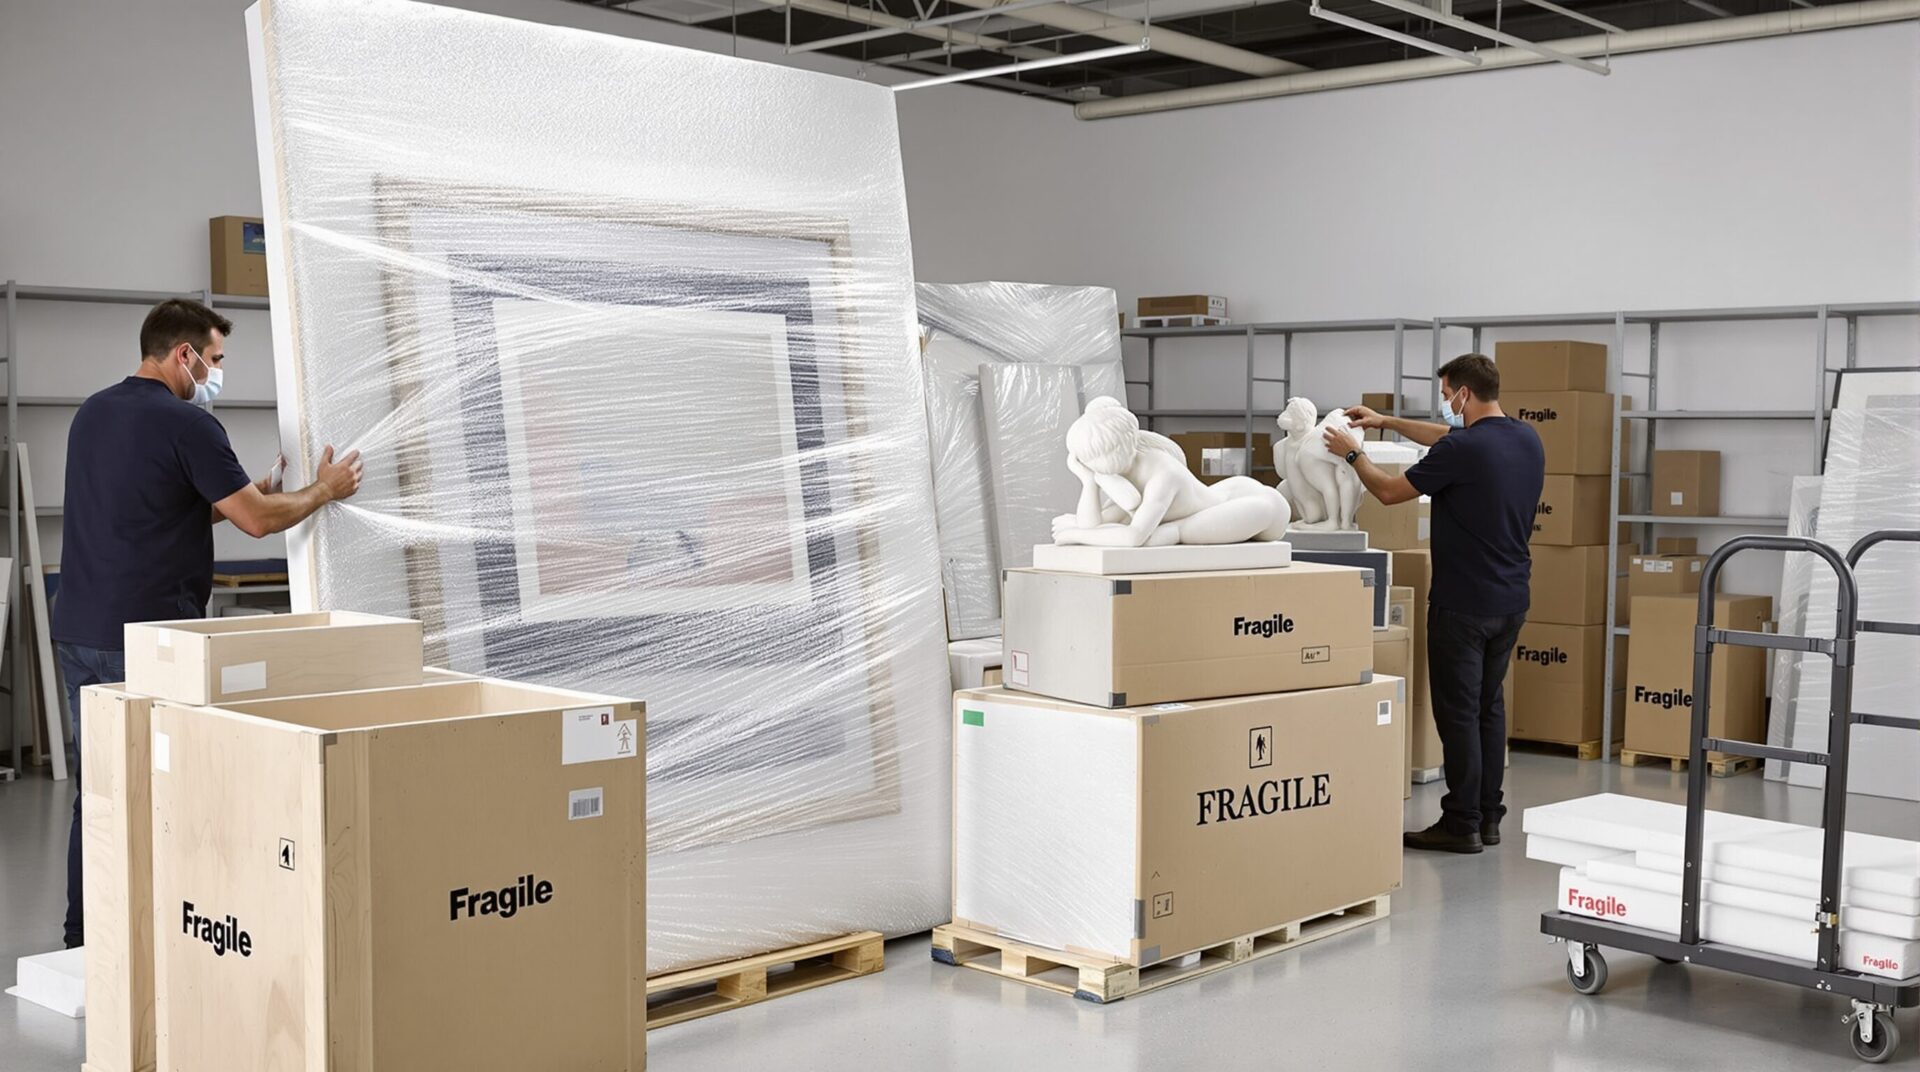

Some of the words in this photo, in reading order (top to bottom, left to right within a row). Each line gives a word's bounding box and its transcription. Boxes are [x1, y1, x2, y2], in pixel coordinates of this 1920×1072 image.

[1518, 408, 1557, 423] Fragile
[1234, 613, 1294, 639] Fragile
[1516, 645, 1567, 666] Fragile
[1634, 686, 1692, 709] Fragile
[1196, 773, 1331, 826] FRAGILE
[449, 873, 553, 920] Fragile
[1567, 889, 1627, 917] Fragile
[182, 901, 252, 957] Fragile
